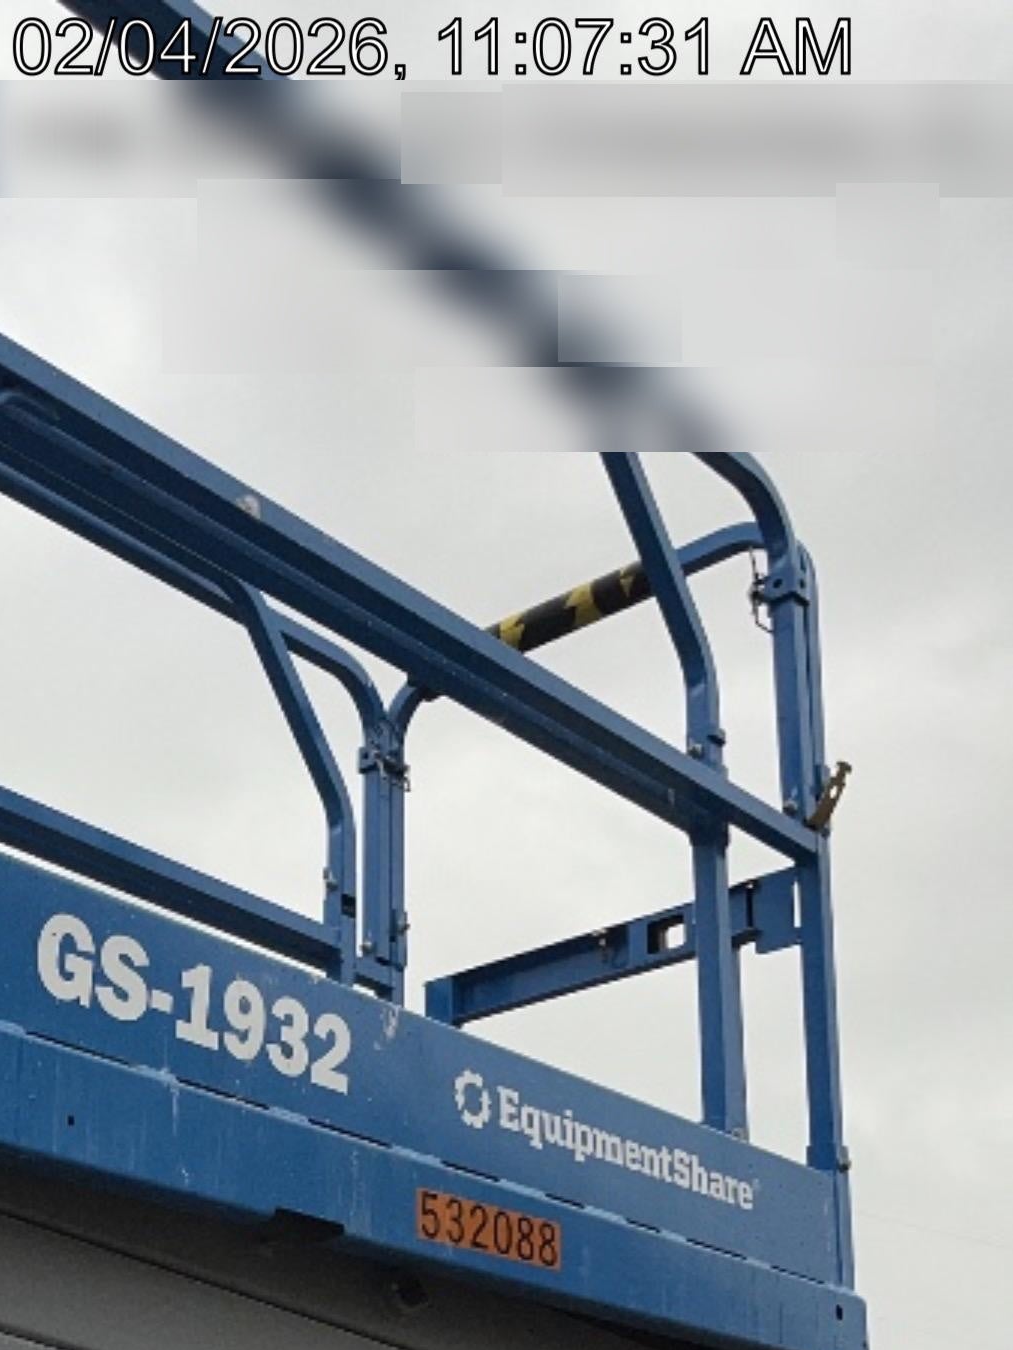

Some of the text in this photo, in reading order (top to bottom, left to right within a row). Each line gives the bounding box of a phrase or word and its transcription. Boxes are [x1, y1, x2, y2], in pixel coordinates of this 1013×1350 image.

[37, 914, 351, 1095] GS-1932
[497, 1086, 755, 1211] EquipmentShare
[420, 1192, 560, 1267] 532088
